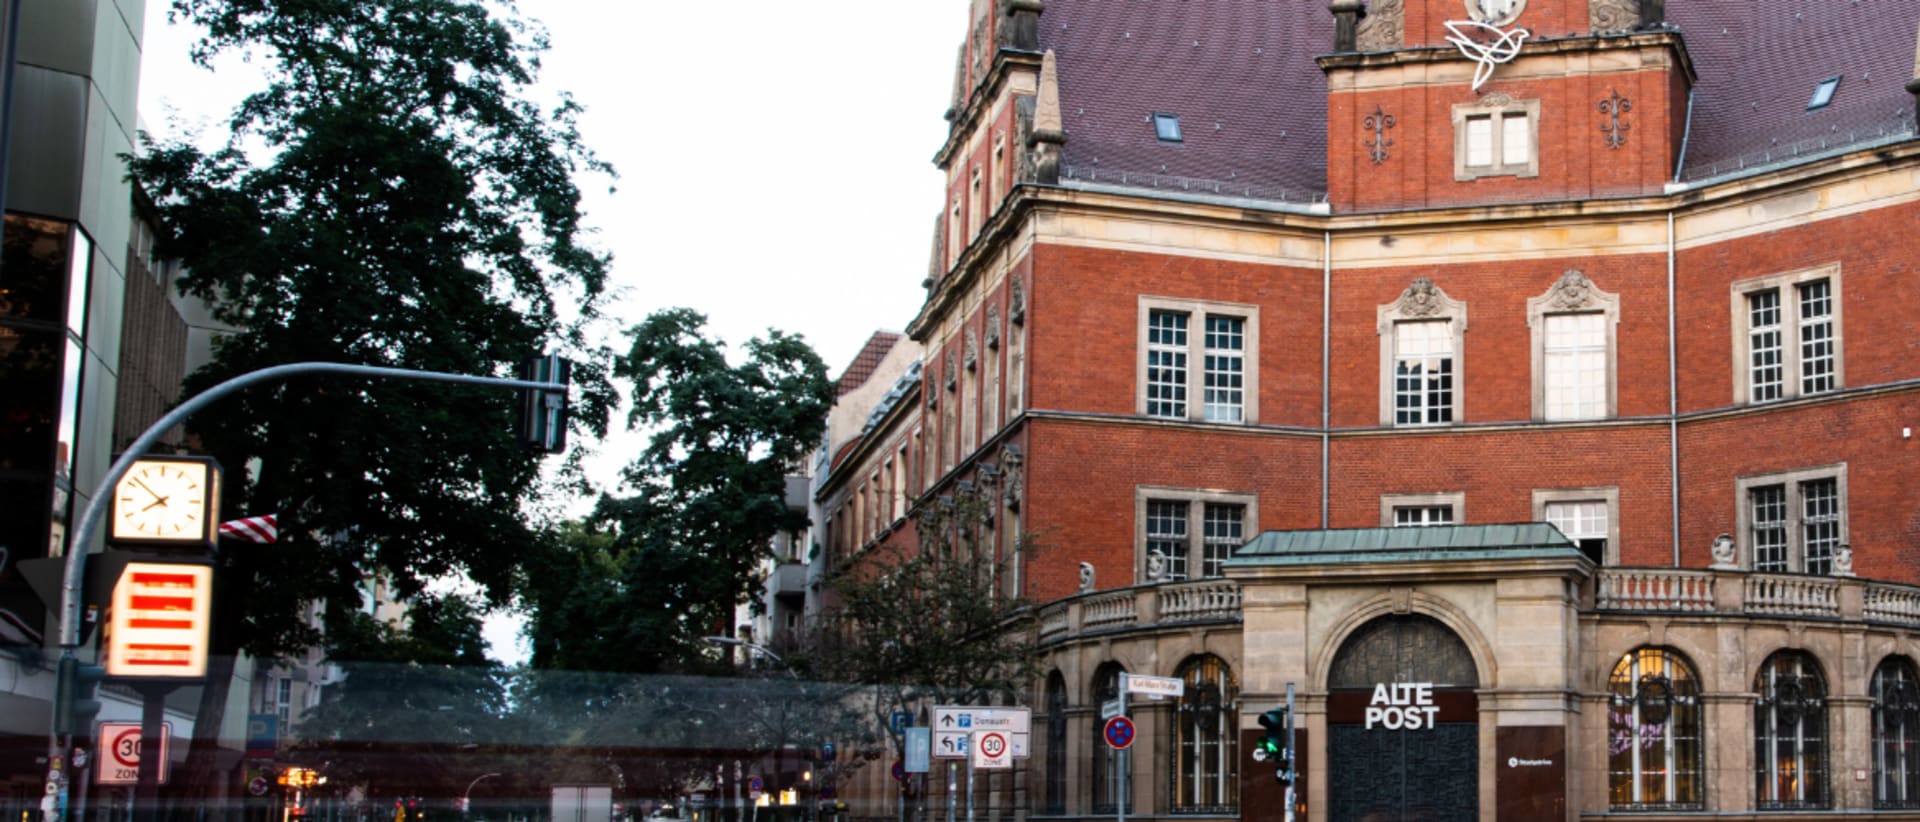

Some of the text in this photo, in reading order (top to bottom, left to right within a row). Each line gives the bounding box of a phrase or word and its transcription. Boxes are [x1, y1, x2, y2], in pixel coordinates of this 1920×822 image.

[1370, 682, 1433, 705] ALTE
[1365, 706, 1440, 730] POST
[986, 739, 1001, 752] 30
[115, 769, 141, 779] ZON
